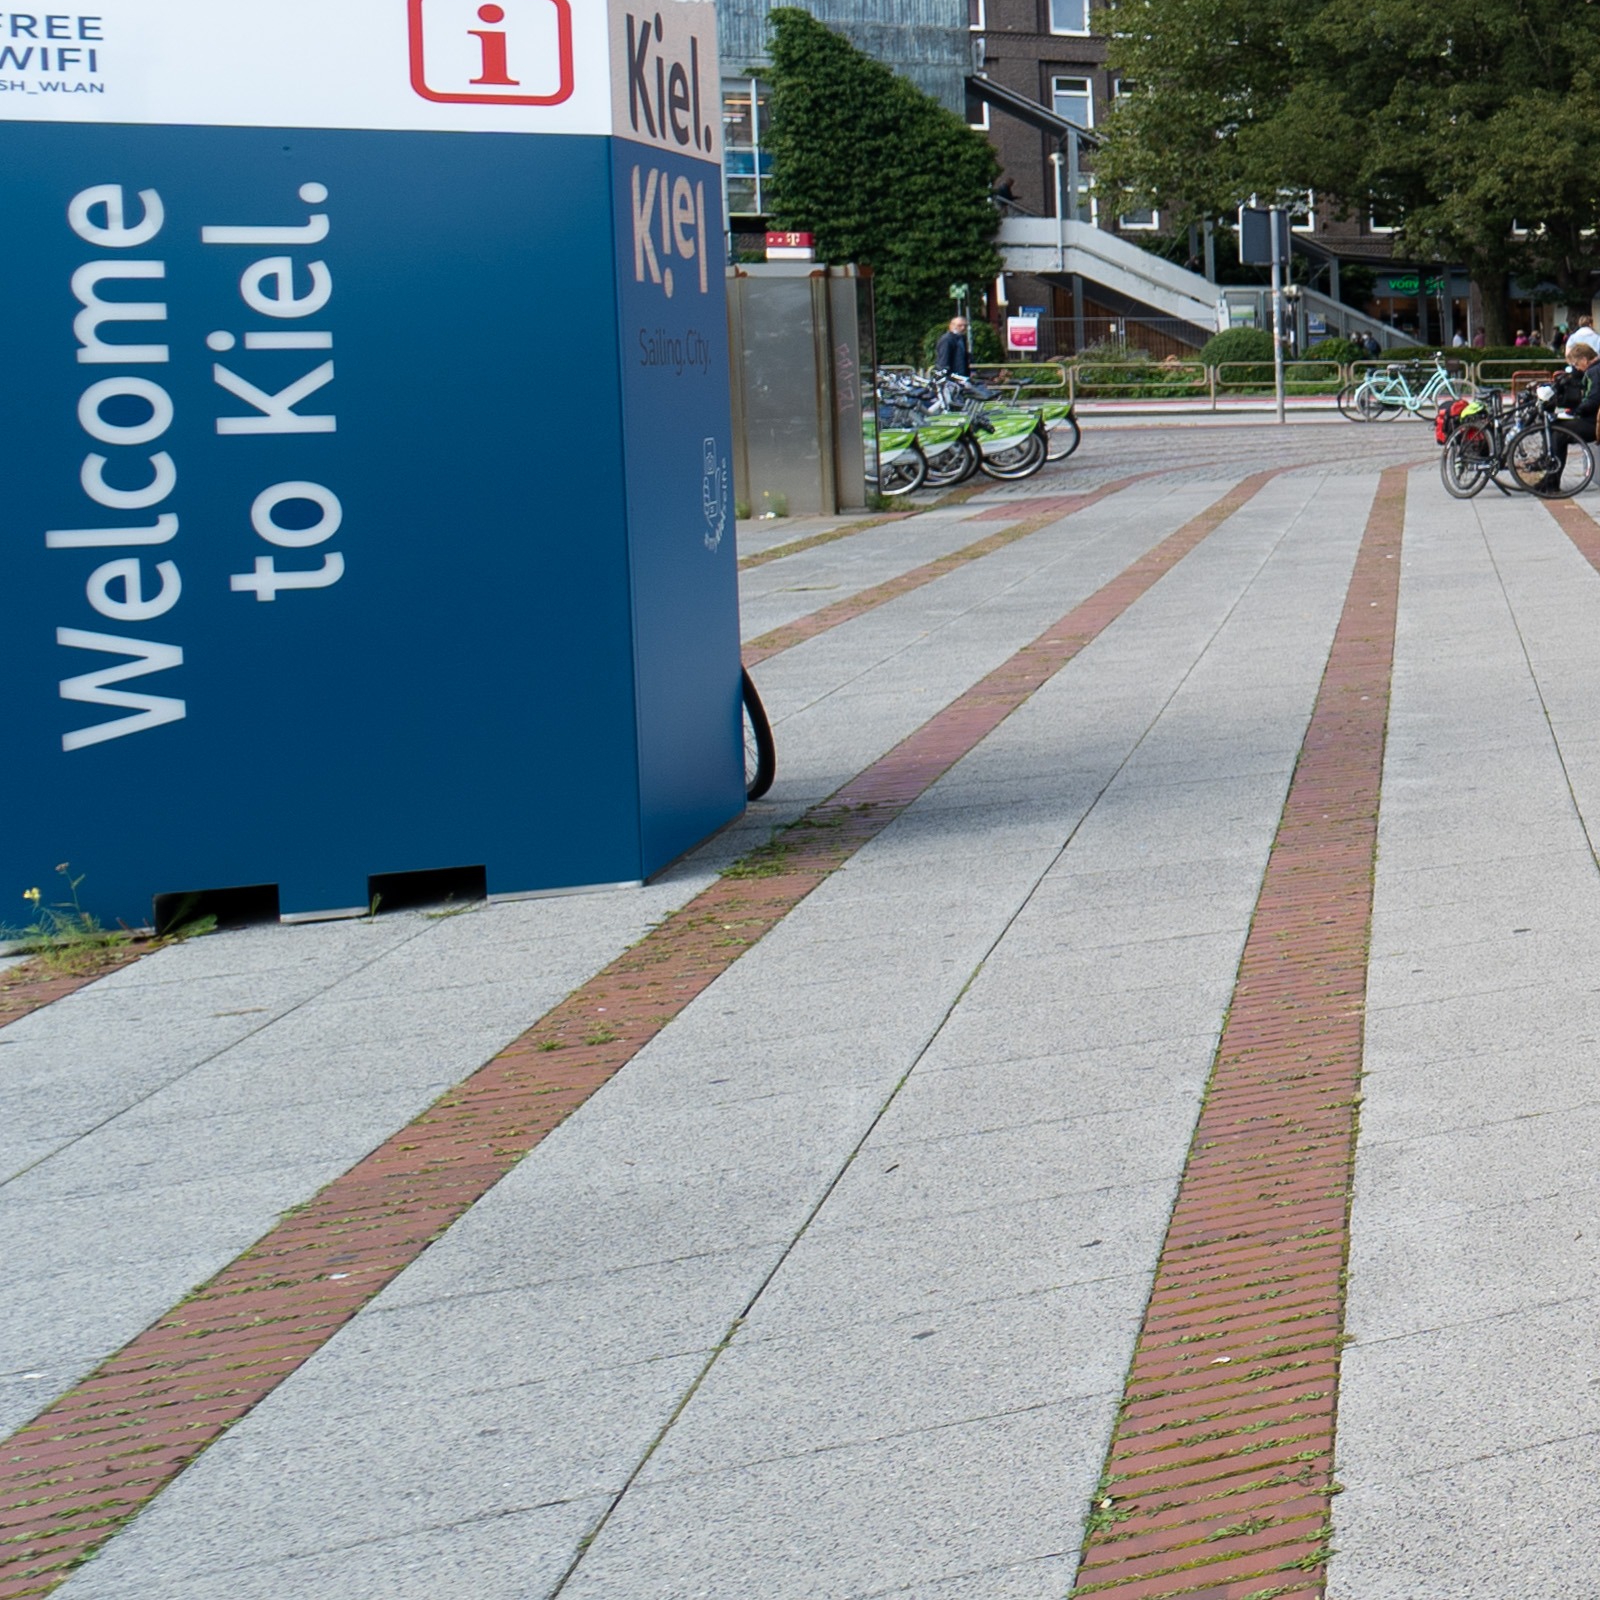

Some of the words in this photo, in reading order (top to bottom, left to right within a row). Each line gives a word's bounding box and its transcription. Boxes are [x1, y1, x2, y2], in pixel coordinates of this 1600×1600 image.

[0, 13, 104, 41] REE
[0, 46, 97, 73] WIFI
[626, 12, 713, 154] Kiel.
[201, 181, 337, 435] Kiel.
[45, 184, 187, 752] Welcome
[230, 481, 345, 602] to
